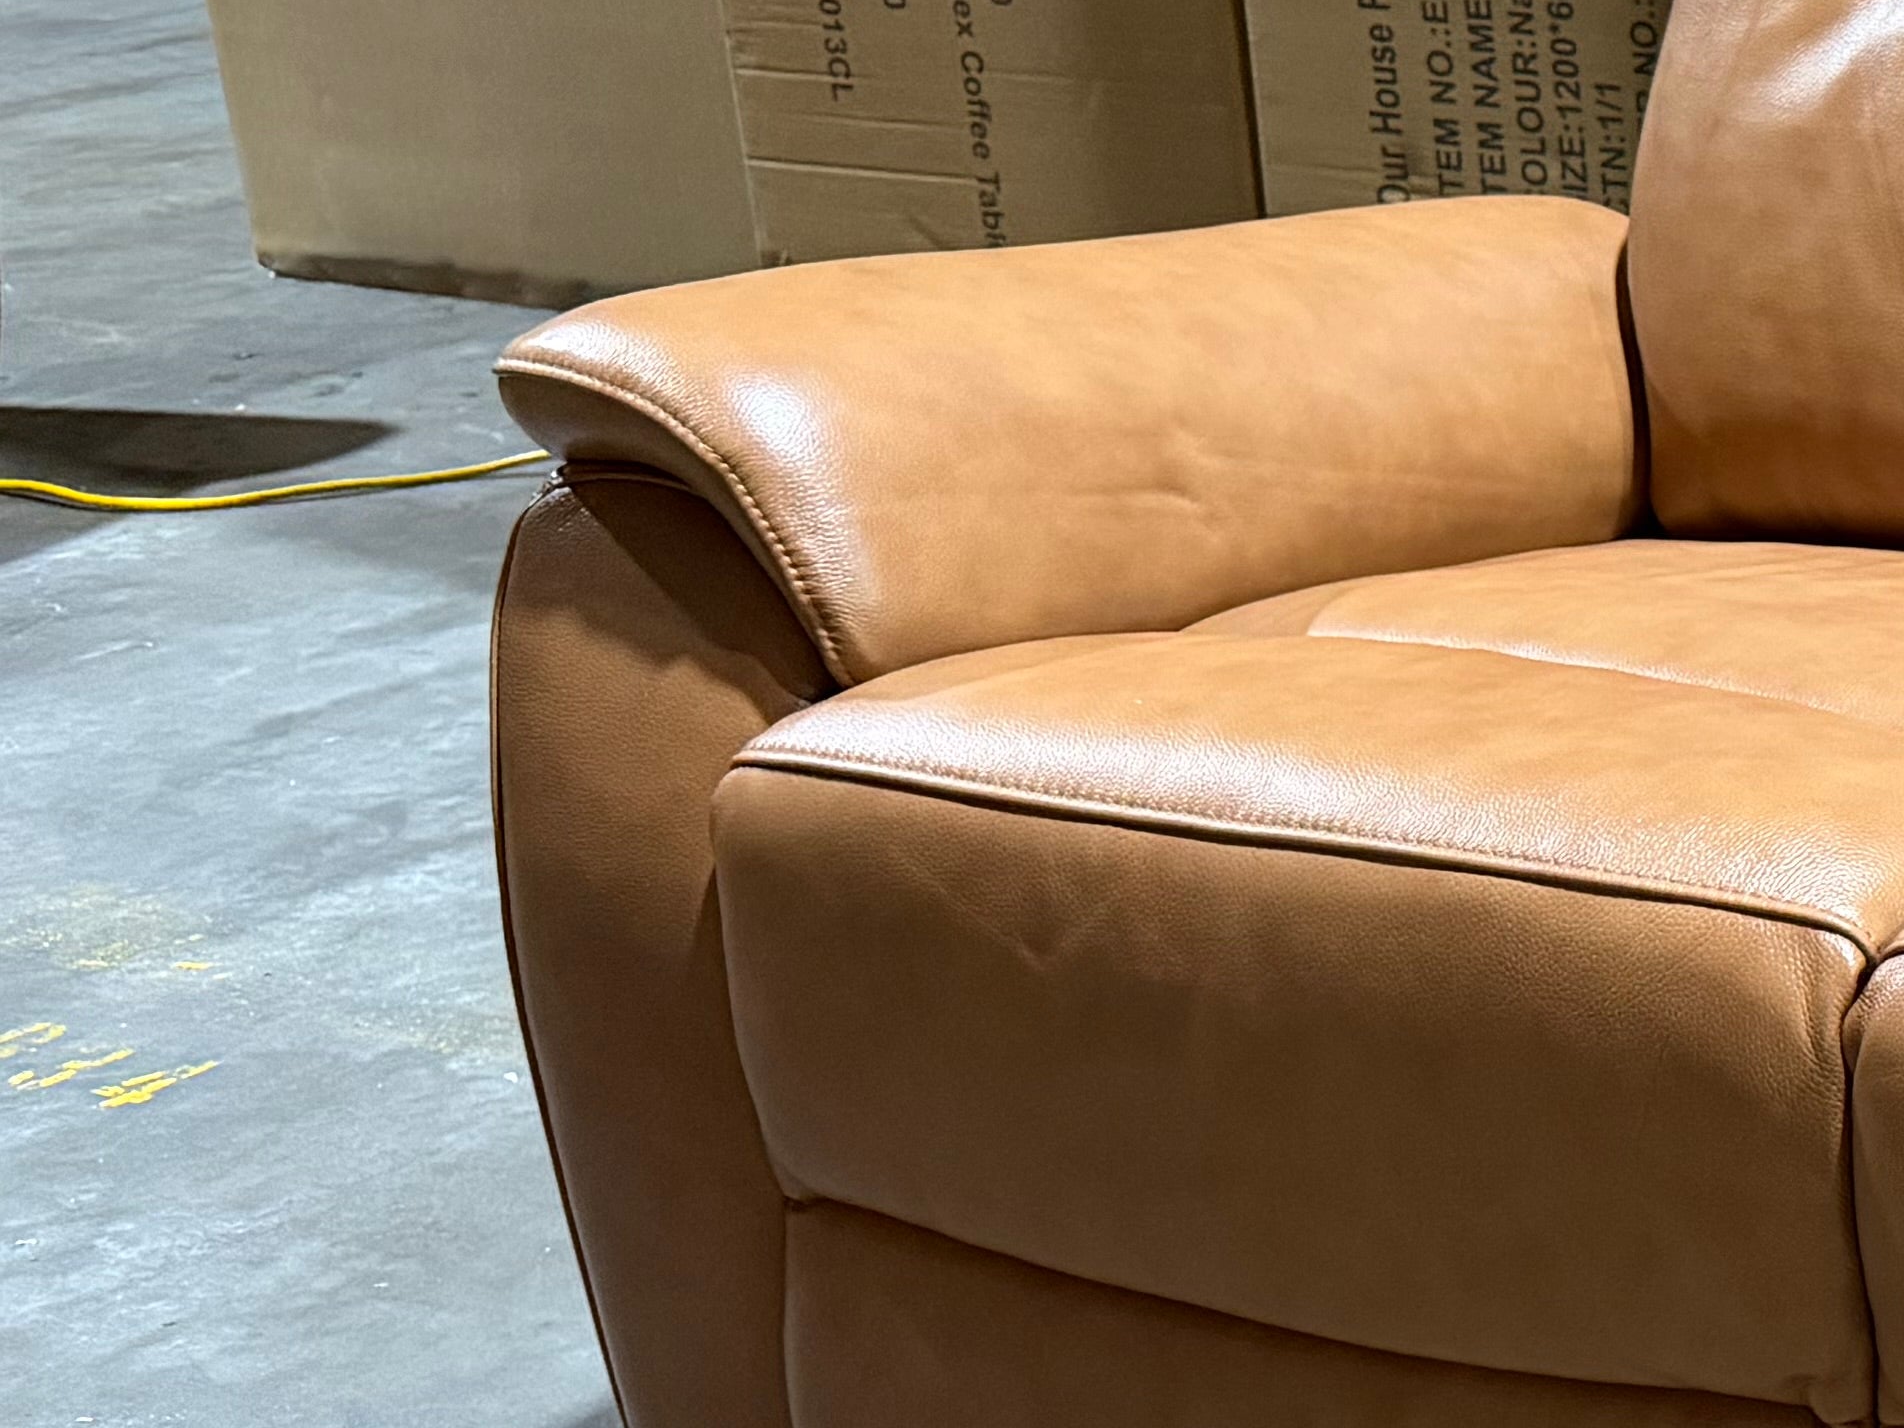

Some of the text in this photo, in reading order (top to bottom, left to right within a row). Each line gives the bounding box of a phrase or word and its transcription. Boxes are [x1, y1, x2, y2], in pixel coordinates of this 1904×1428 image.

[960, 50, 991, 160] Coffee
[1369, 23, 1403, 135] House
[1433, 118, 1464, 195] TEM
[1474, 121, 1508, 195] TEM
[975, 171, 1006, 248] Tabl
